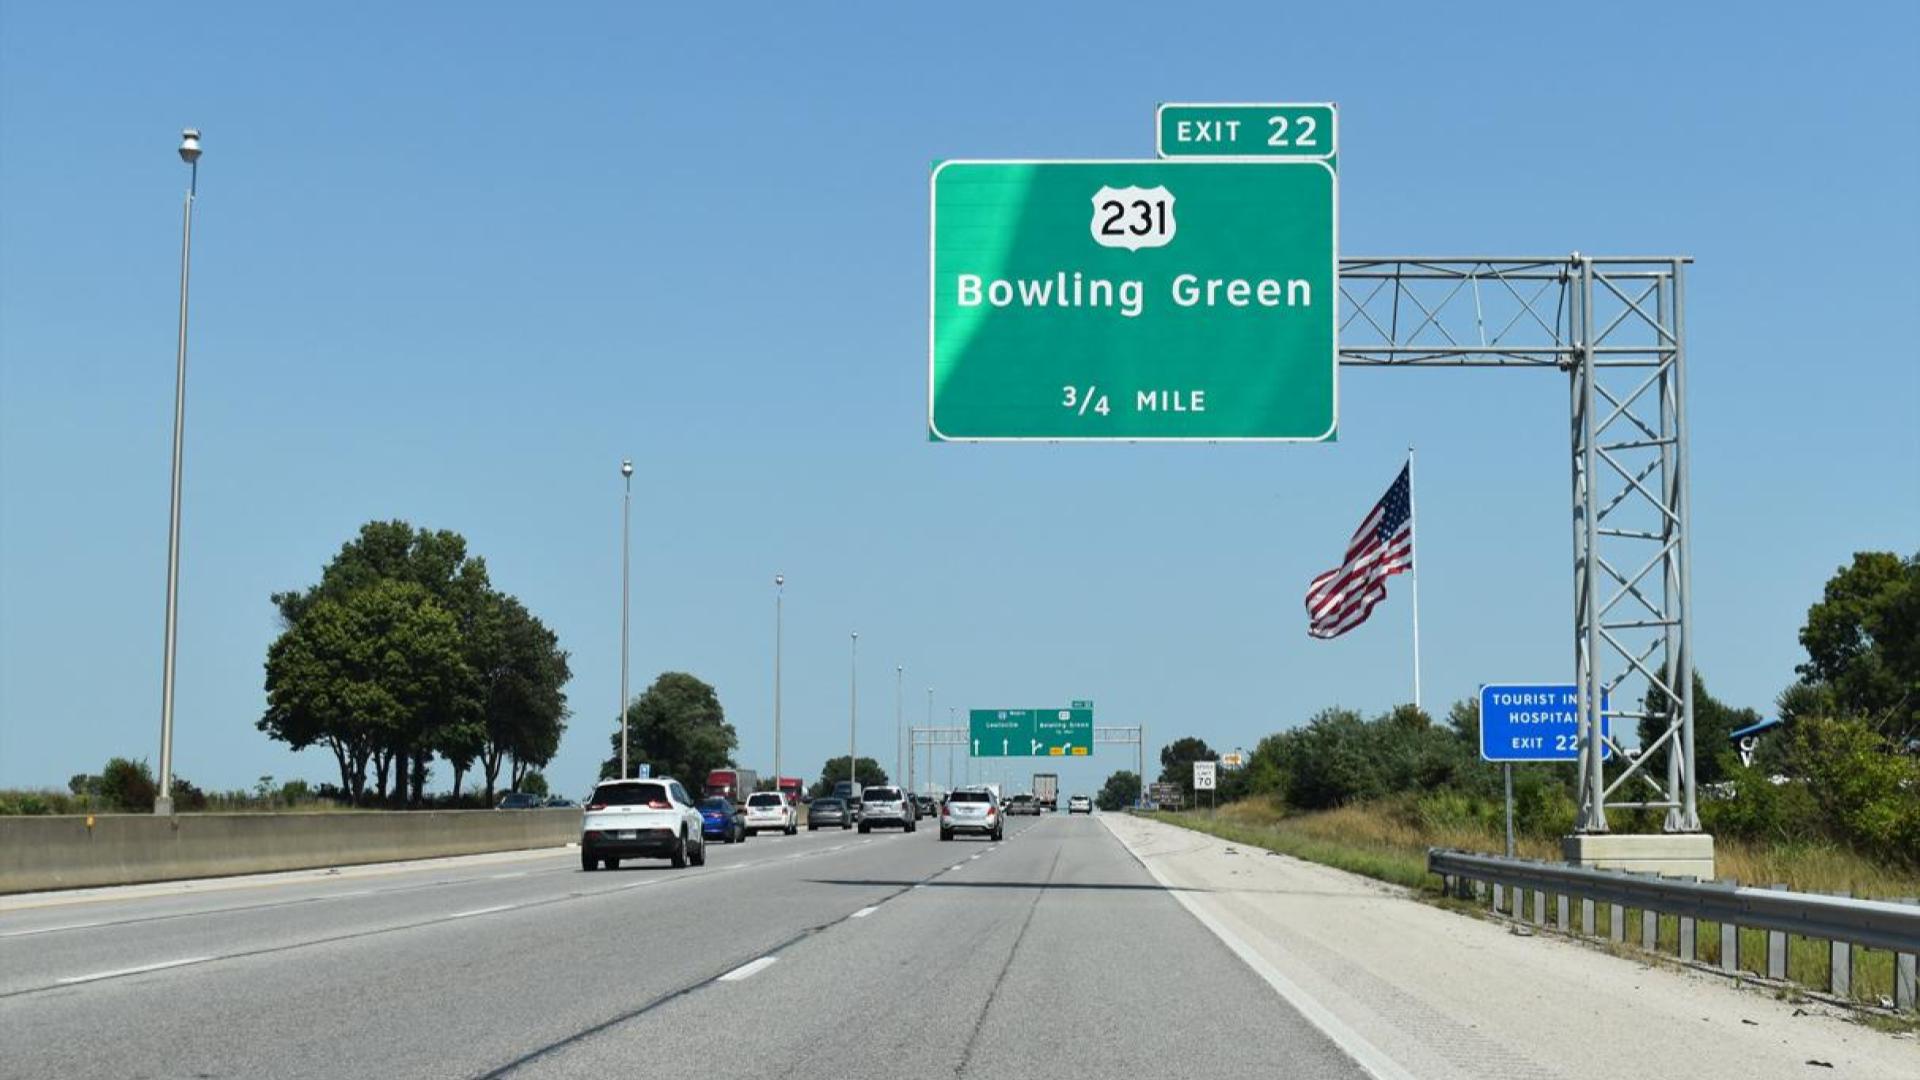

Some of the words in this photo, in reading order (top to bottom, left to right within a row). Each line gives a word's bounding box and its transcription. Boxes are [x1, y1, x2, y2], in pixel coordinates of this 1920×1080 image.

[1177, 120, 1241, 142] EXIT
[1267, 116, 1318, 147] 22
[1101, 200, 1166, 236] 231
[957, 272, 1144, 317] Bowling
[1172, 275, 1311, 307] Green
[1062, 386, 1111, 417] 3/4
[1137, 390, 1206, 412] MILE
[1493, 693, 1556, 705] TOURIST
[1512, 737, 1543, 749] EXIT
[1555, 734, 1579, 751] 22
[1197, 777, 1212, 786] 70
